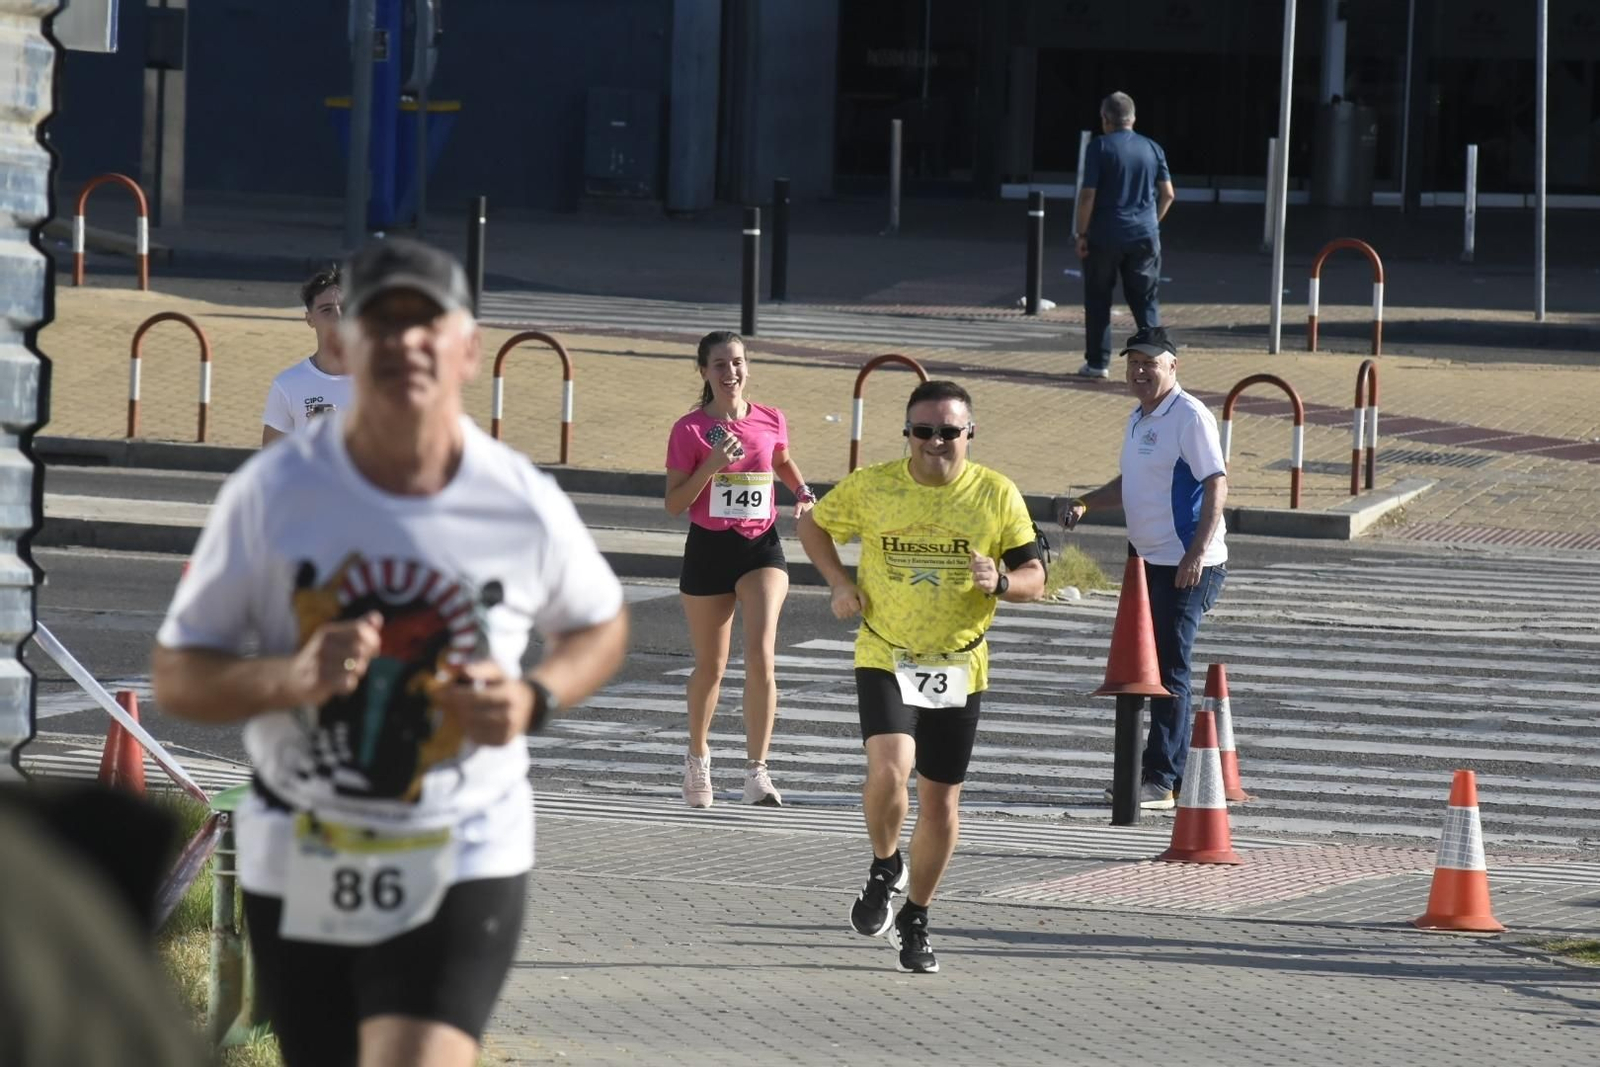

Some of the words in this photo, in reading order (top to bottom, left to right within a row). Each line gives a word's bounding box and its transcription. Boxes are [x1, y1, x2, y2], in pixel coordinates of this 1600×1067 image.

[304, 396, 324, 404] CIPO
[722, 490, 762, 507] 149
[881, 536, 971, 554] HIESSUR
[915, 672, 948, 694] 73
[332, 867, 405, 912] 86
